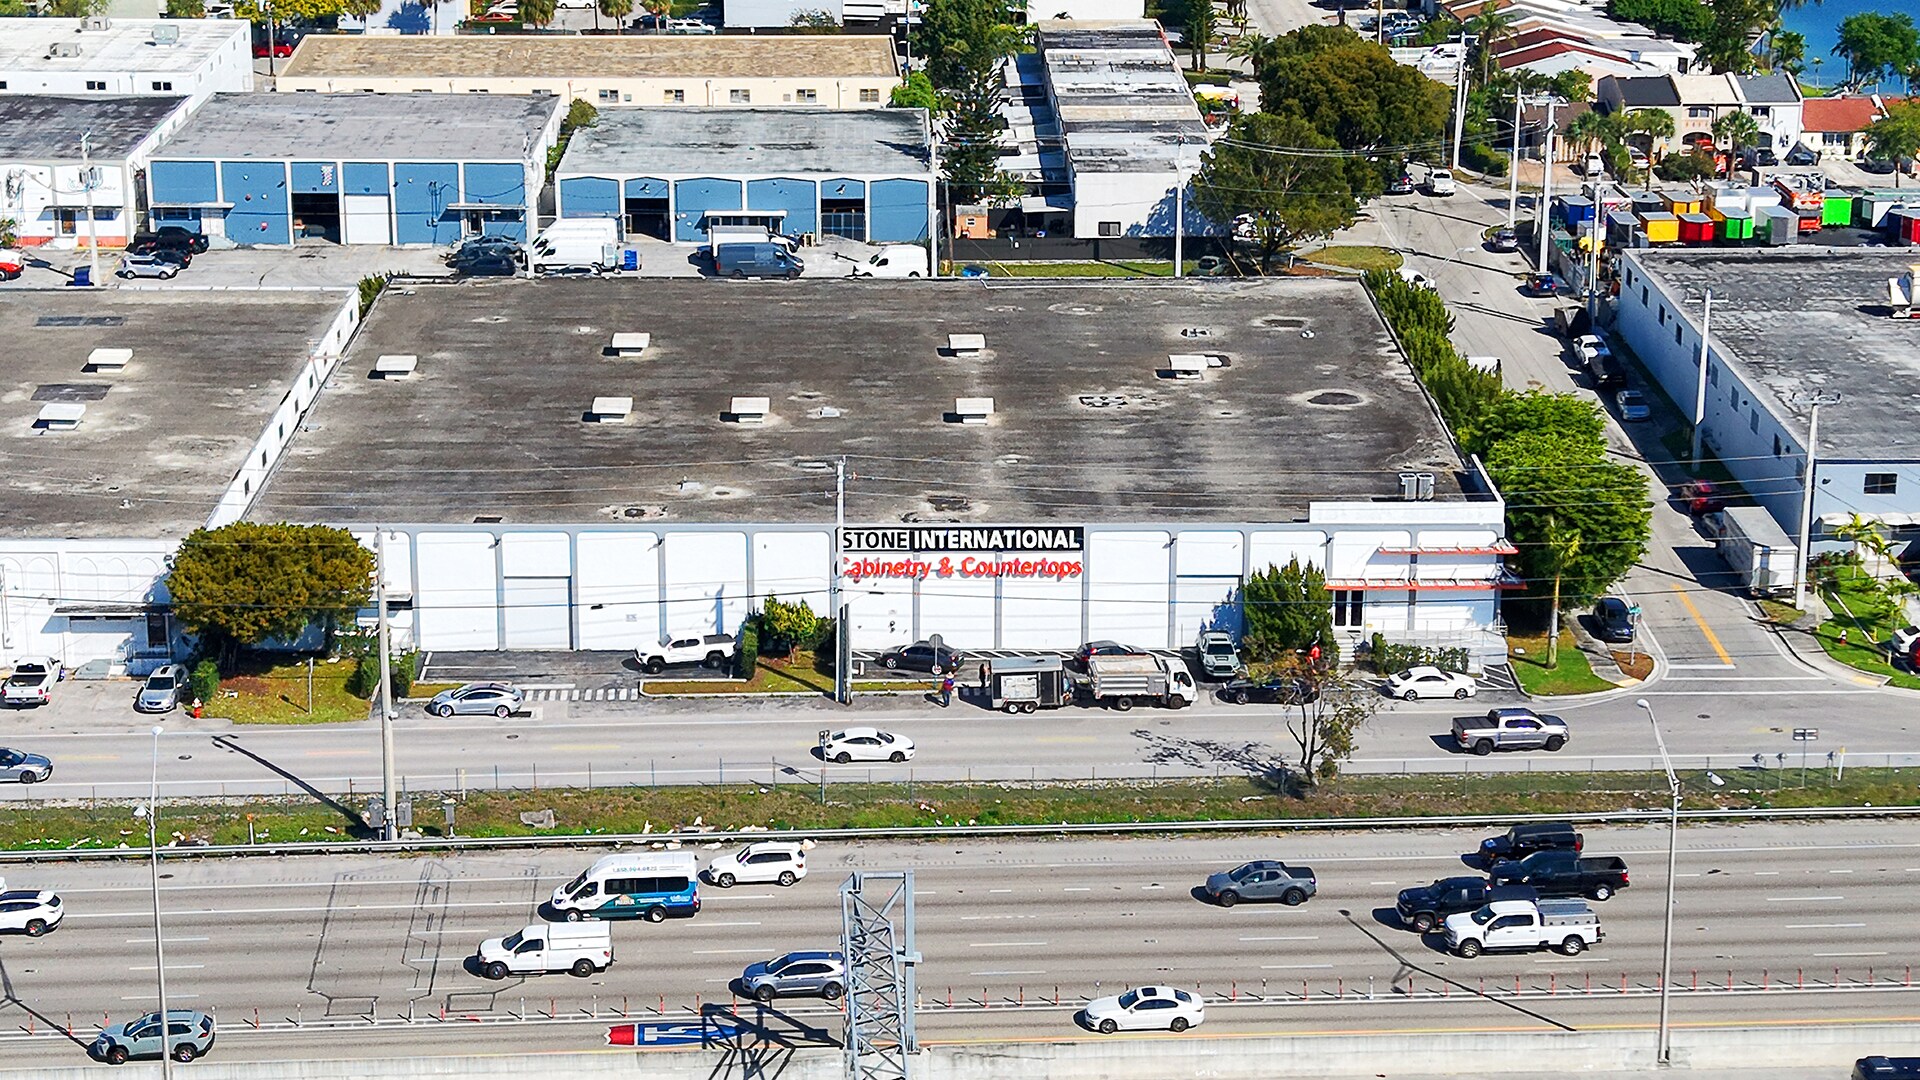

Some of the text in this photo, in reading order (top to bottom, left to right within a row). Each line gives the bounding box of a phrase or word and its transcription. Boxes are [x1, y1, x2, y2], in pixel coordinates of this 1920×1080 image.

[842, 529, 1081, 550] STONE INTERNATIONAL
[938, 556, 955, 576] &
[961, 556, 1083, 582] Countertops
